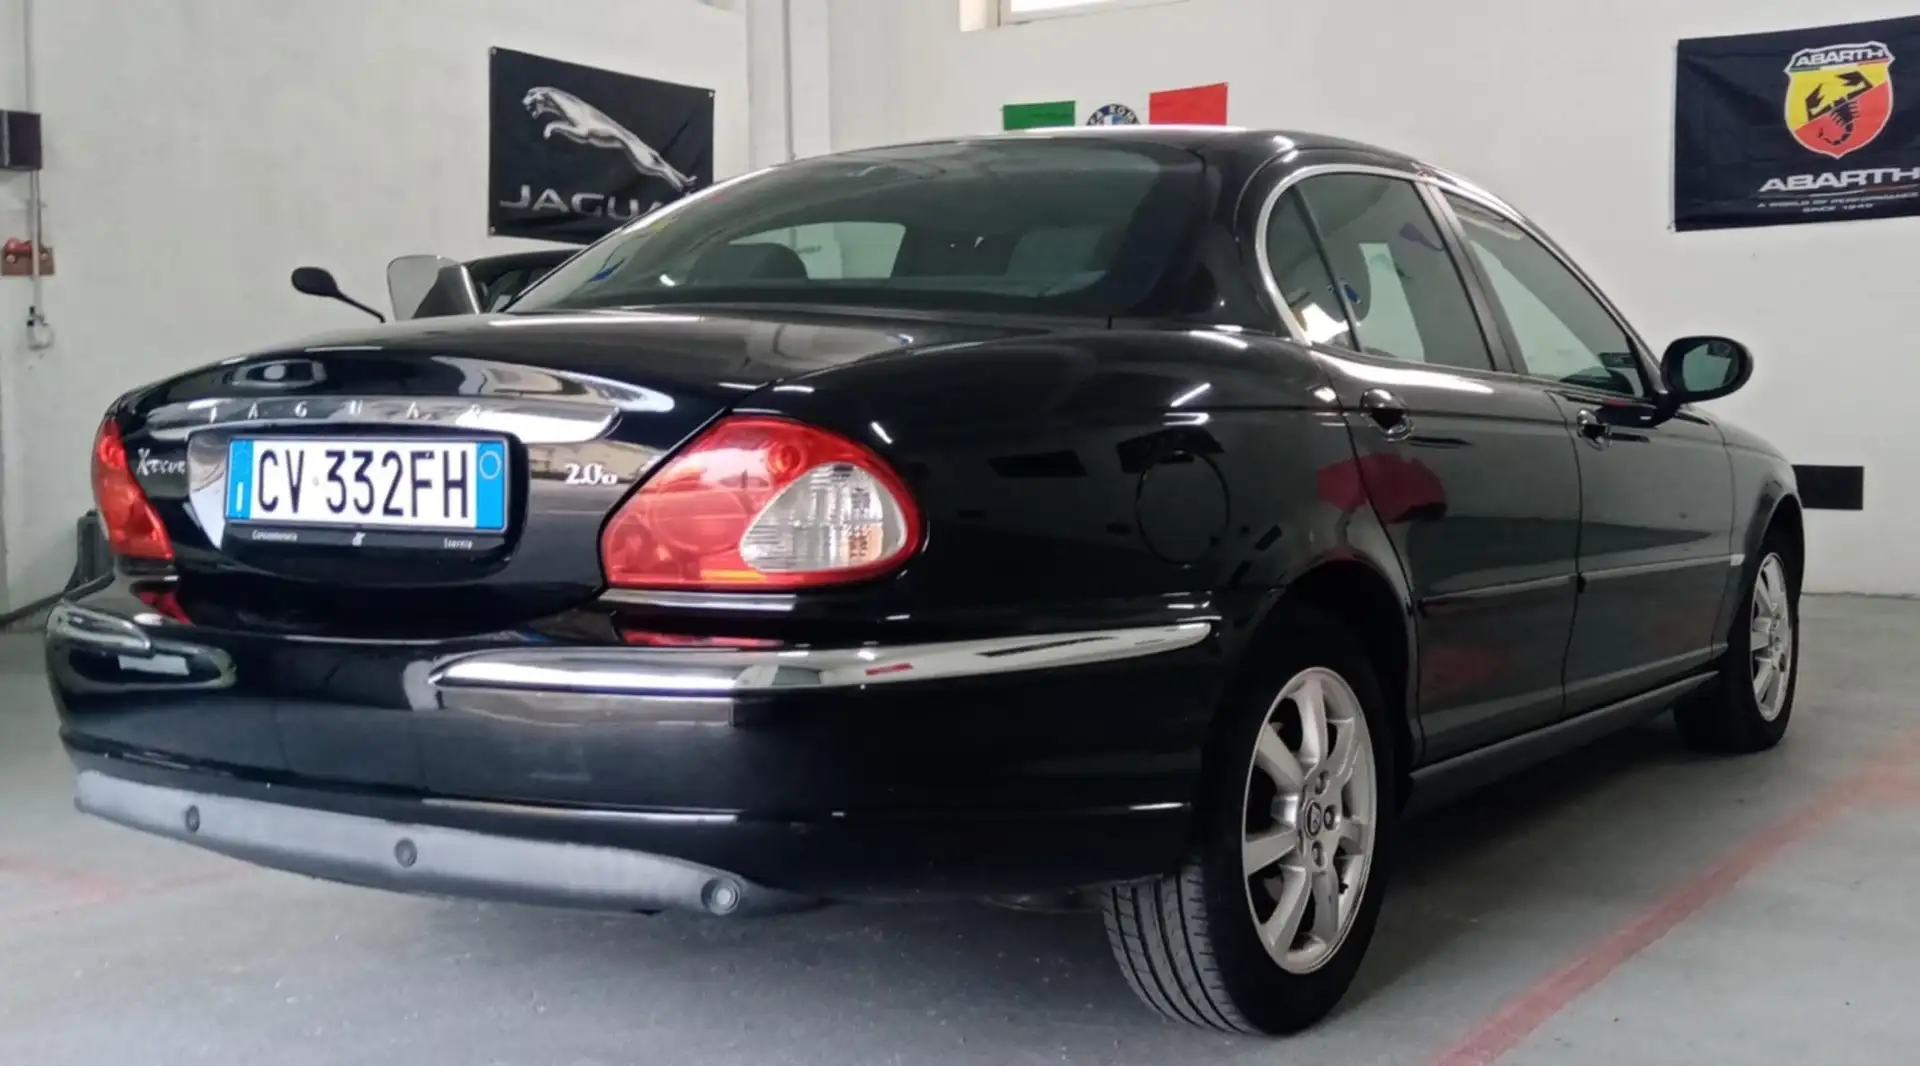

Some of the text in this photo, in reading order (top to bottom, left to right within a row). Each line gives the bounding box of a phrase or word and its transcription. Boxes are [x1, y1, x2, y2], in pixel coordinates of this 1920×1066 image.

[1796, 49, 1884, 67] ABARTH
[1758, 166, 1920, 192] ABARTH
[500, 184, 662, 220] JAGU
[258, 449, 305, 514] CV
